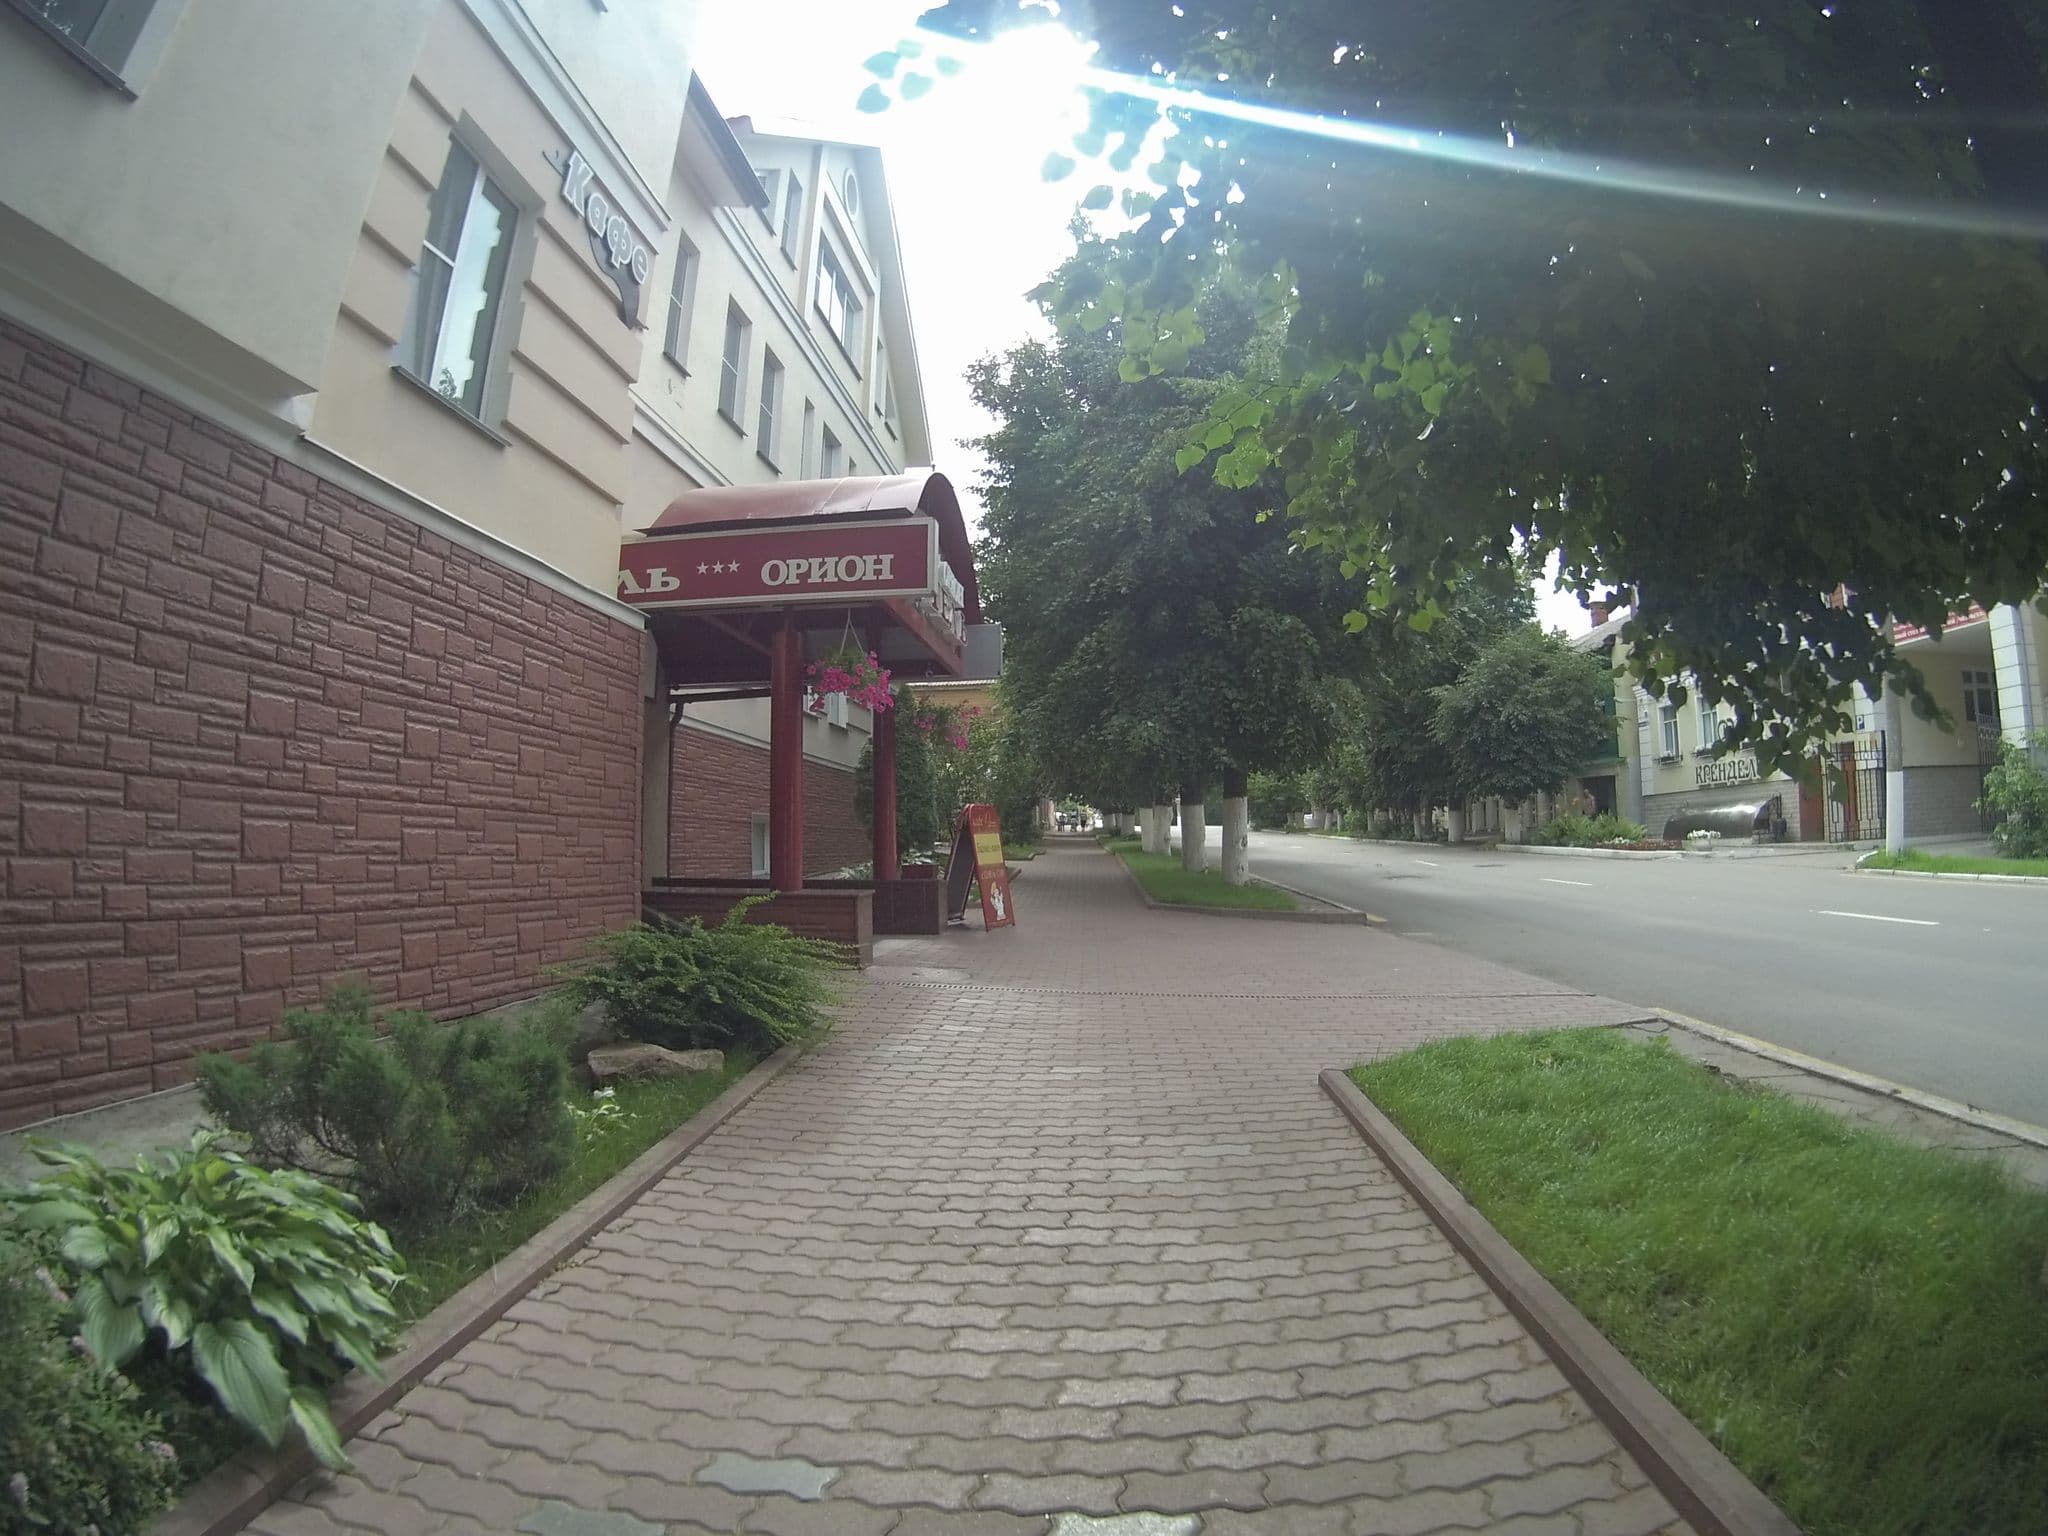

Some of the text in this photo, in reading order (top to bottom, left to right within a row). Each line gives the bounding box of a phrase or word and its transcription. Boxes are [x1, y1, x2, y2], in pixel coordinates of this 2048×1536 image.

[563, 151, 649, 285] Кафе
[760, 553, 895, 586] ОРИОН
[1695, 758, 1762, 785] КРЕНДЕЛ
